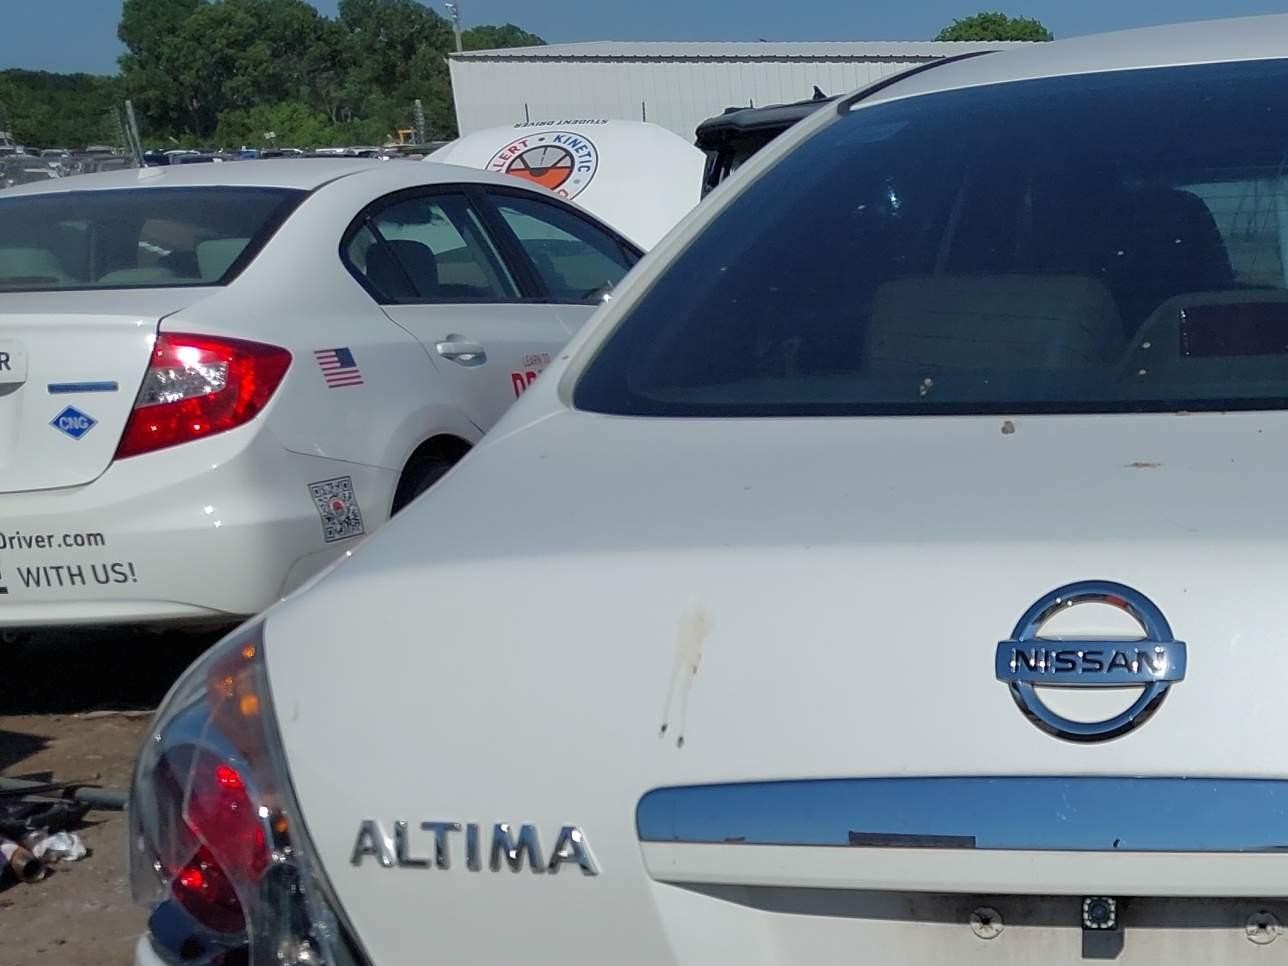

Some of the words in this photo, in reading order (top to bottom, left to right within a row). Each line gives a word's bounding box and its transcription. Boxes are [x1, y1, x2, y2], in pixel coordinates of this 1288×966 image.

[492, 139, 529, 173] LERT
[553, 133, 593, 173] KINETIC
[59, 416, 90, 430] CNG
[16, 564, 87, 588] WITH
[90, 561, 138, 585] US!
[1009, 647, 1168, 675] NISSAN
[350, 819, 602, 877] ALTIMA
